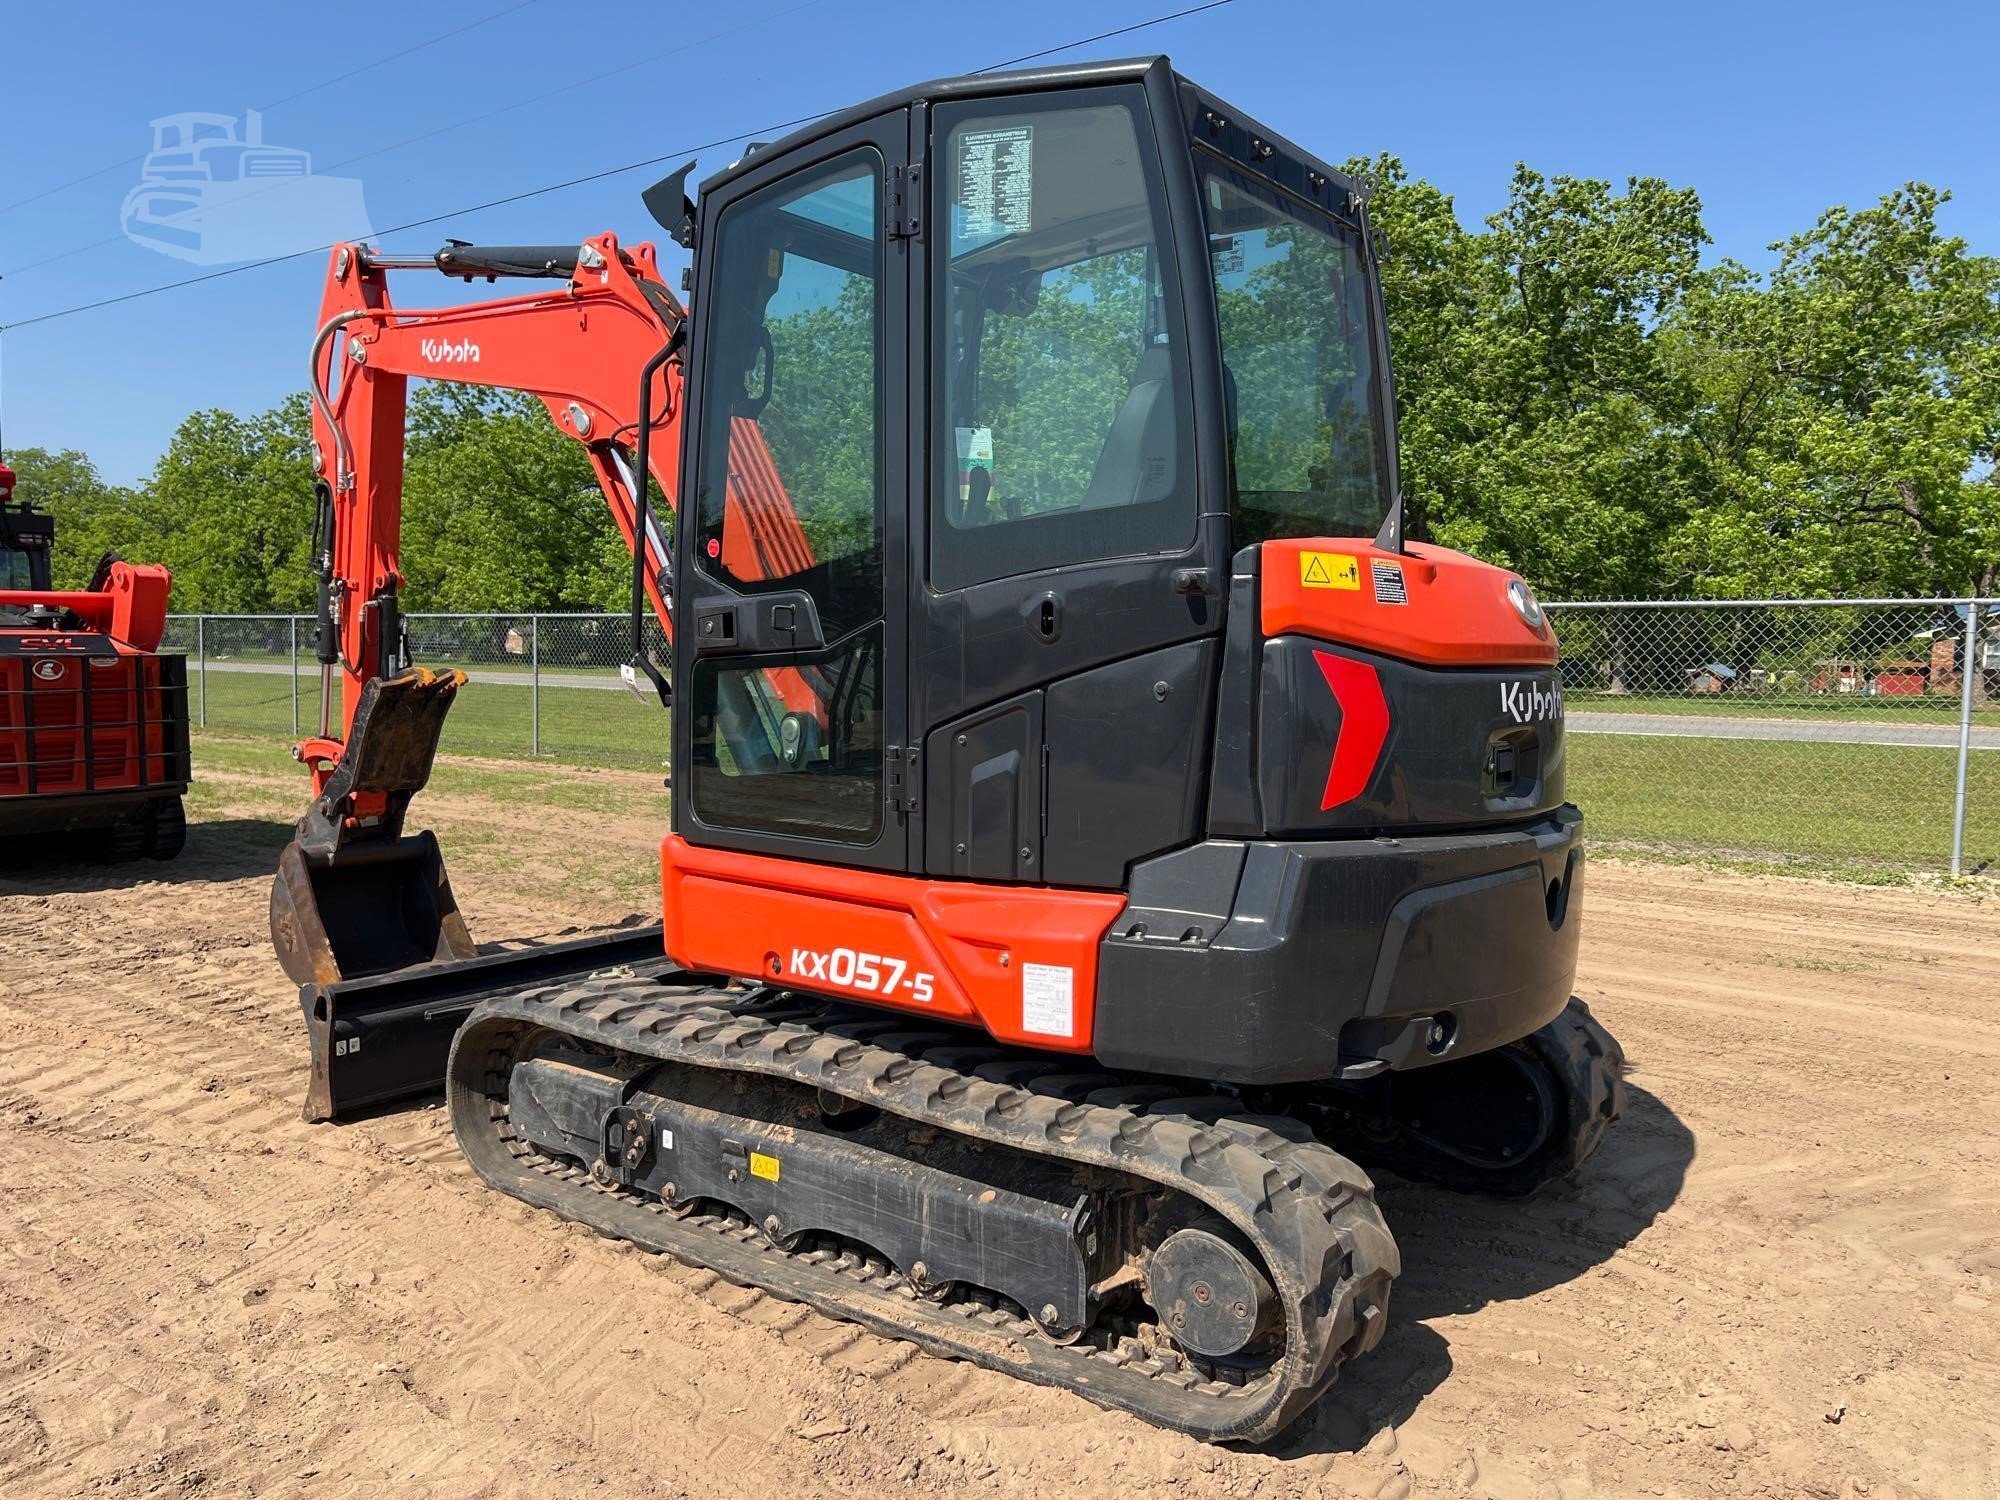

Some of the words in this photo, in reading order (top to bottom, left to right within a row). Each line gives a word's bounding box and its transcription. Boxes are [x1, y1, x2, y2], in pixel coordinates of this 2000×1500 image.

[421, 337, 480, 363] Kubota
[19, 637, 87, 650] SVL
[1500, 680, 1562, 723] Kubota
[789, 947, 935, 1002] KX057-5
